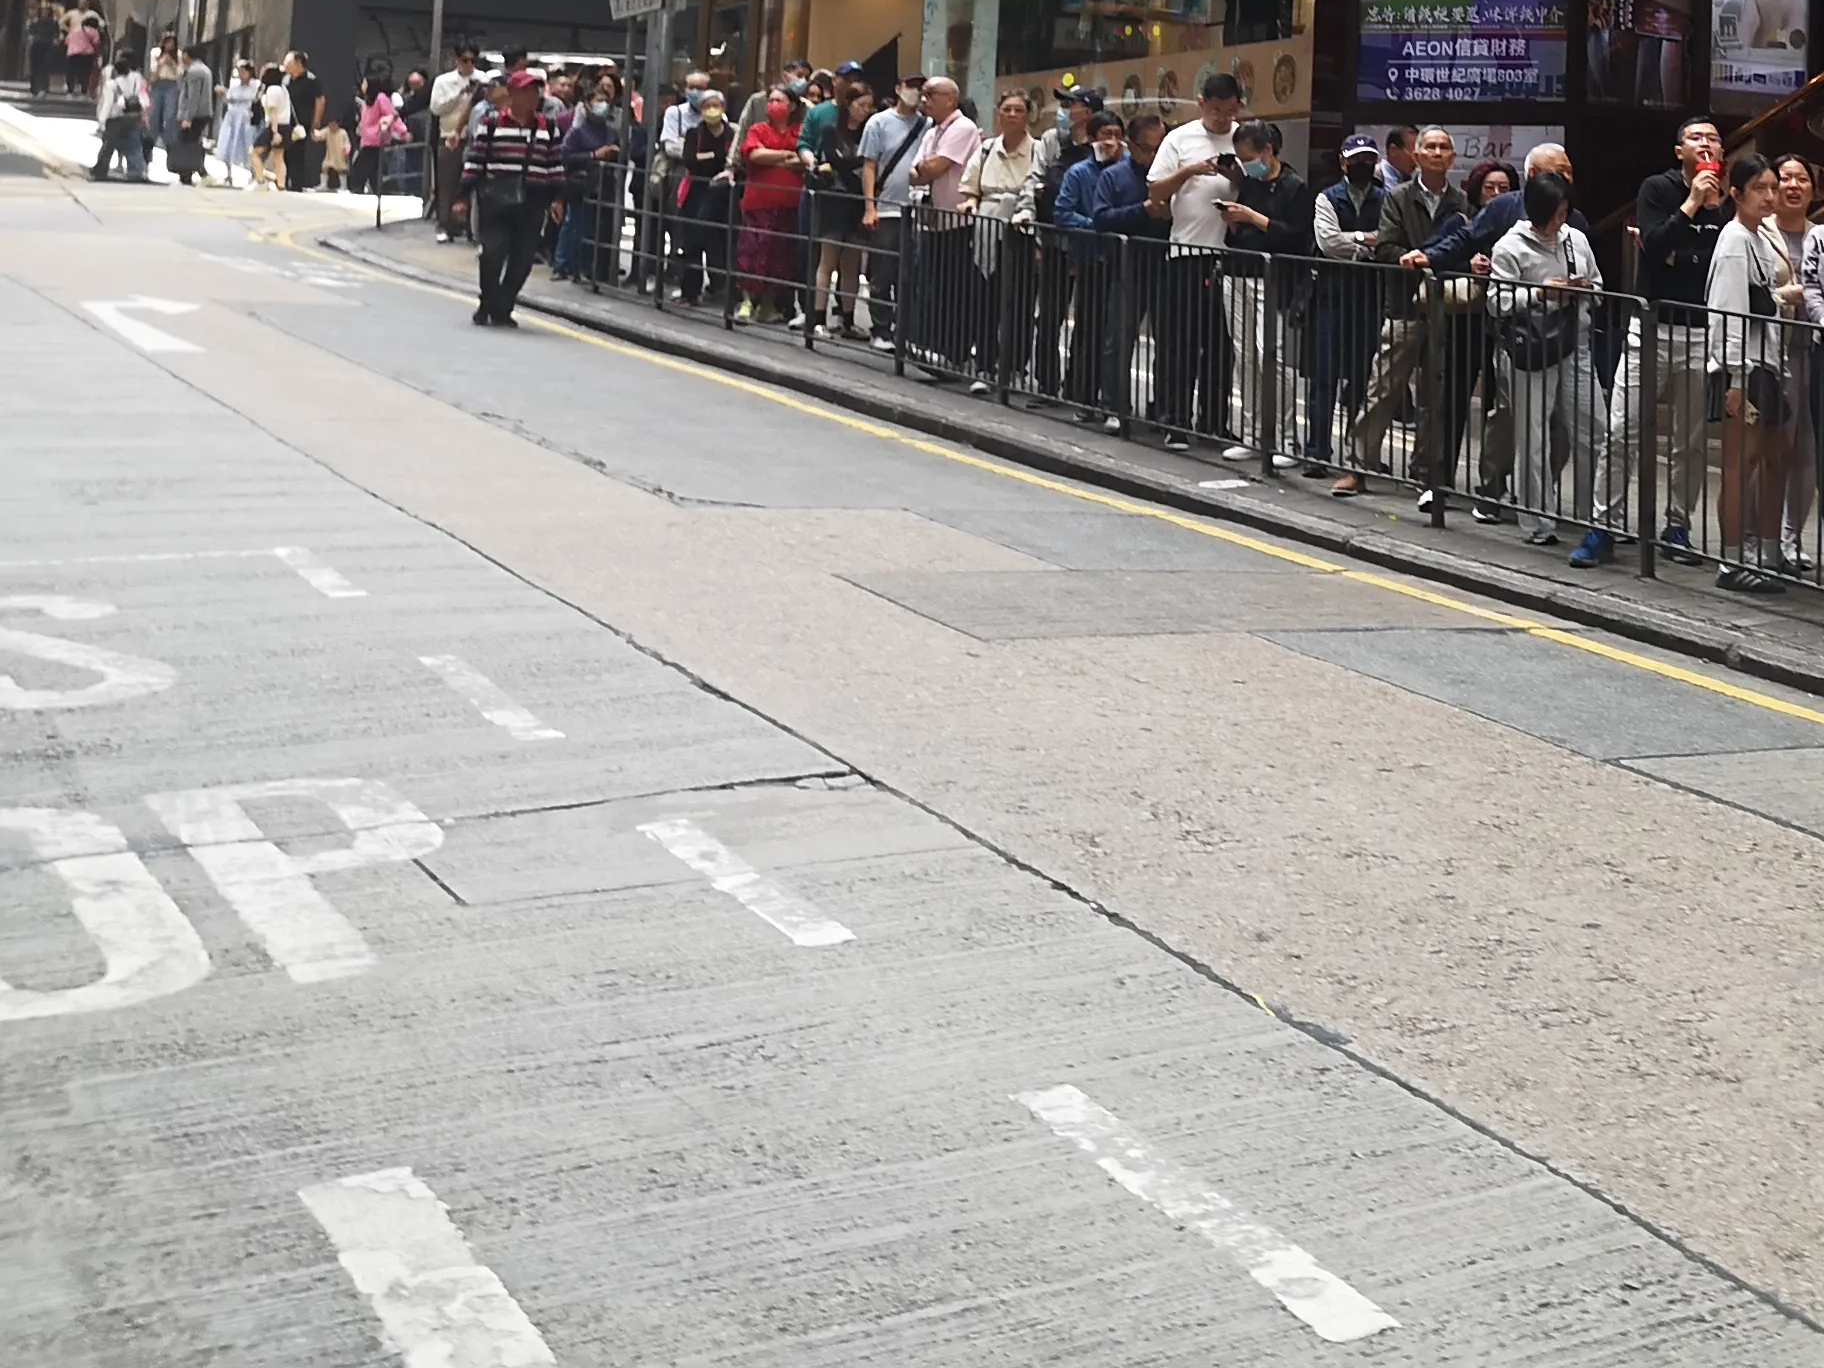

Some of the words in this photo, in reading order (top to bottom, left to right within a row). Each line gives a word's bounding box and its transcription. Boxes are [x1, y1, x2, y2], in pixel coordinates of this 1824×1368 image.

[1402, 38, 1526, 56] AEON信貸財務
[1405, 87, 1441, 101] 3628
[1446, 87, 1481, 101] 4027
